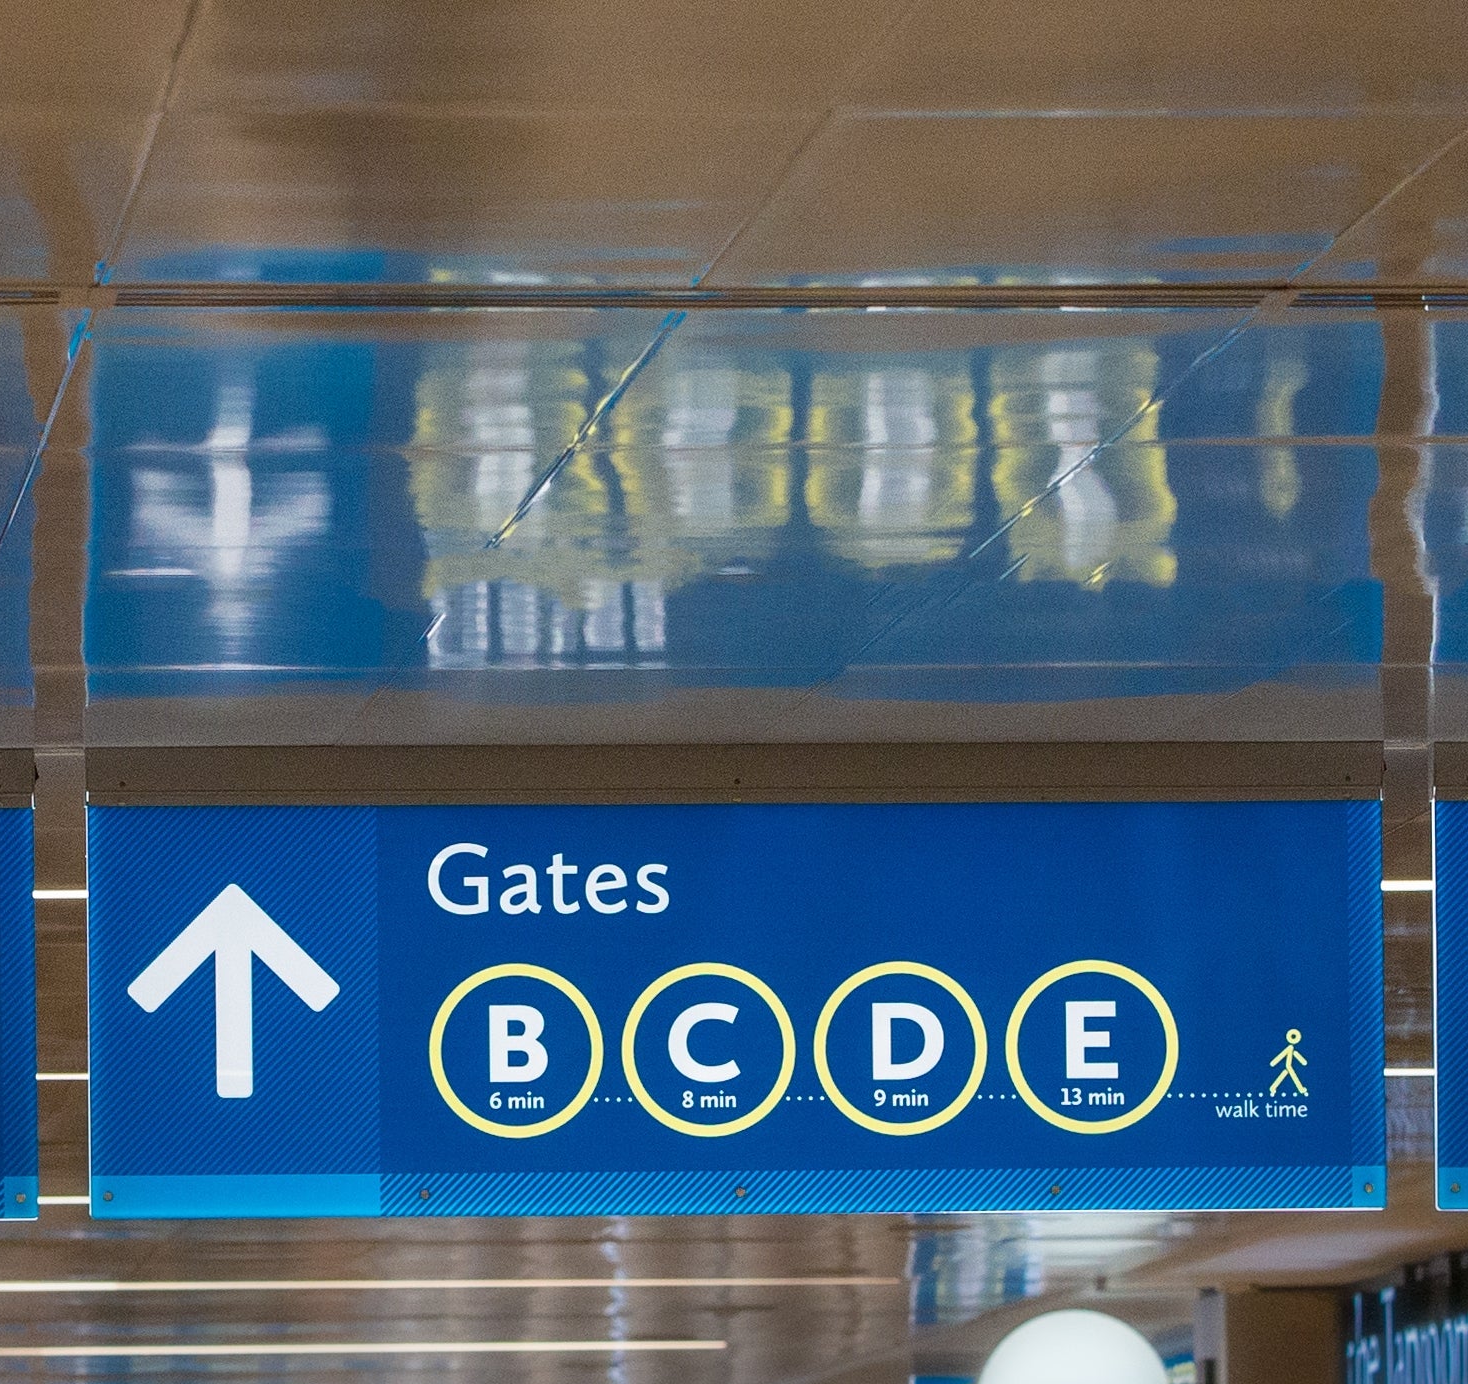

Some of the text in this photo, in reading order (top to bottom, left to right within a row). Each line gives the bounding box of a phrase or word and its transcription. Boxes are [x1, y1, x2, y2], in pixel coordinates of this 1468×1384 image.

[427, 842, 670, 915] Gates
[488, 1004, 549, 1083] B
[667, 1002, 741, 1083] C
[871, 1002, 945, 1081] D
[1065, 1000, 1119, 1079] E
[489, 1091, 545, 1110] 6 min
[681, 1089, 737, 1109] 8 min
[873, 1088, 929, 1107] 9 min
[1060, 1087, 1125, 1106] 13 min
[1215, 1099, 1309, 1118] walk time
